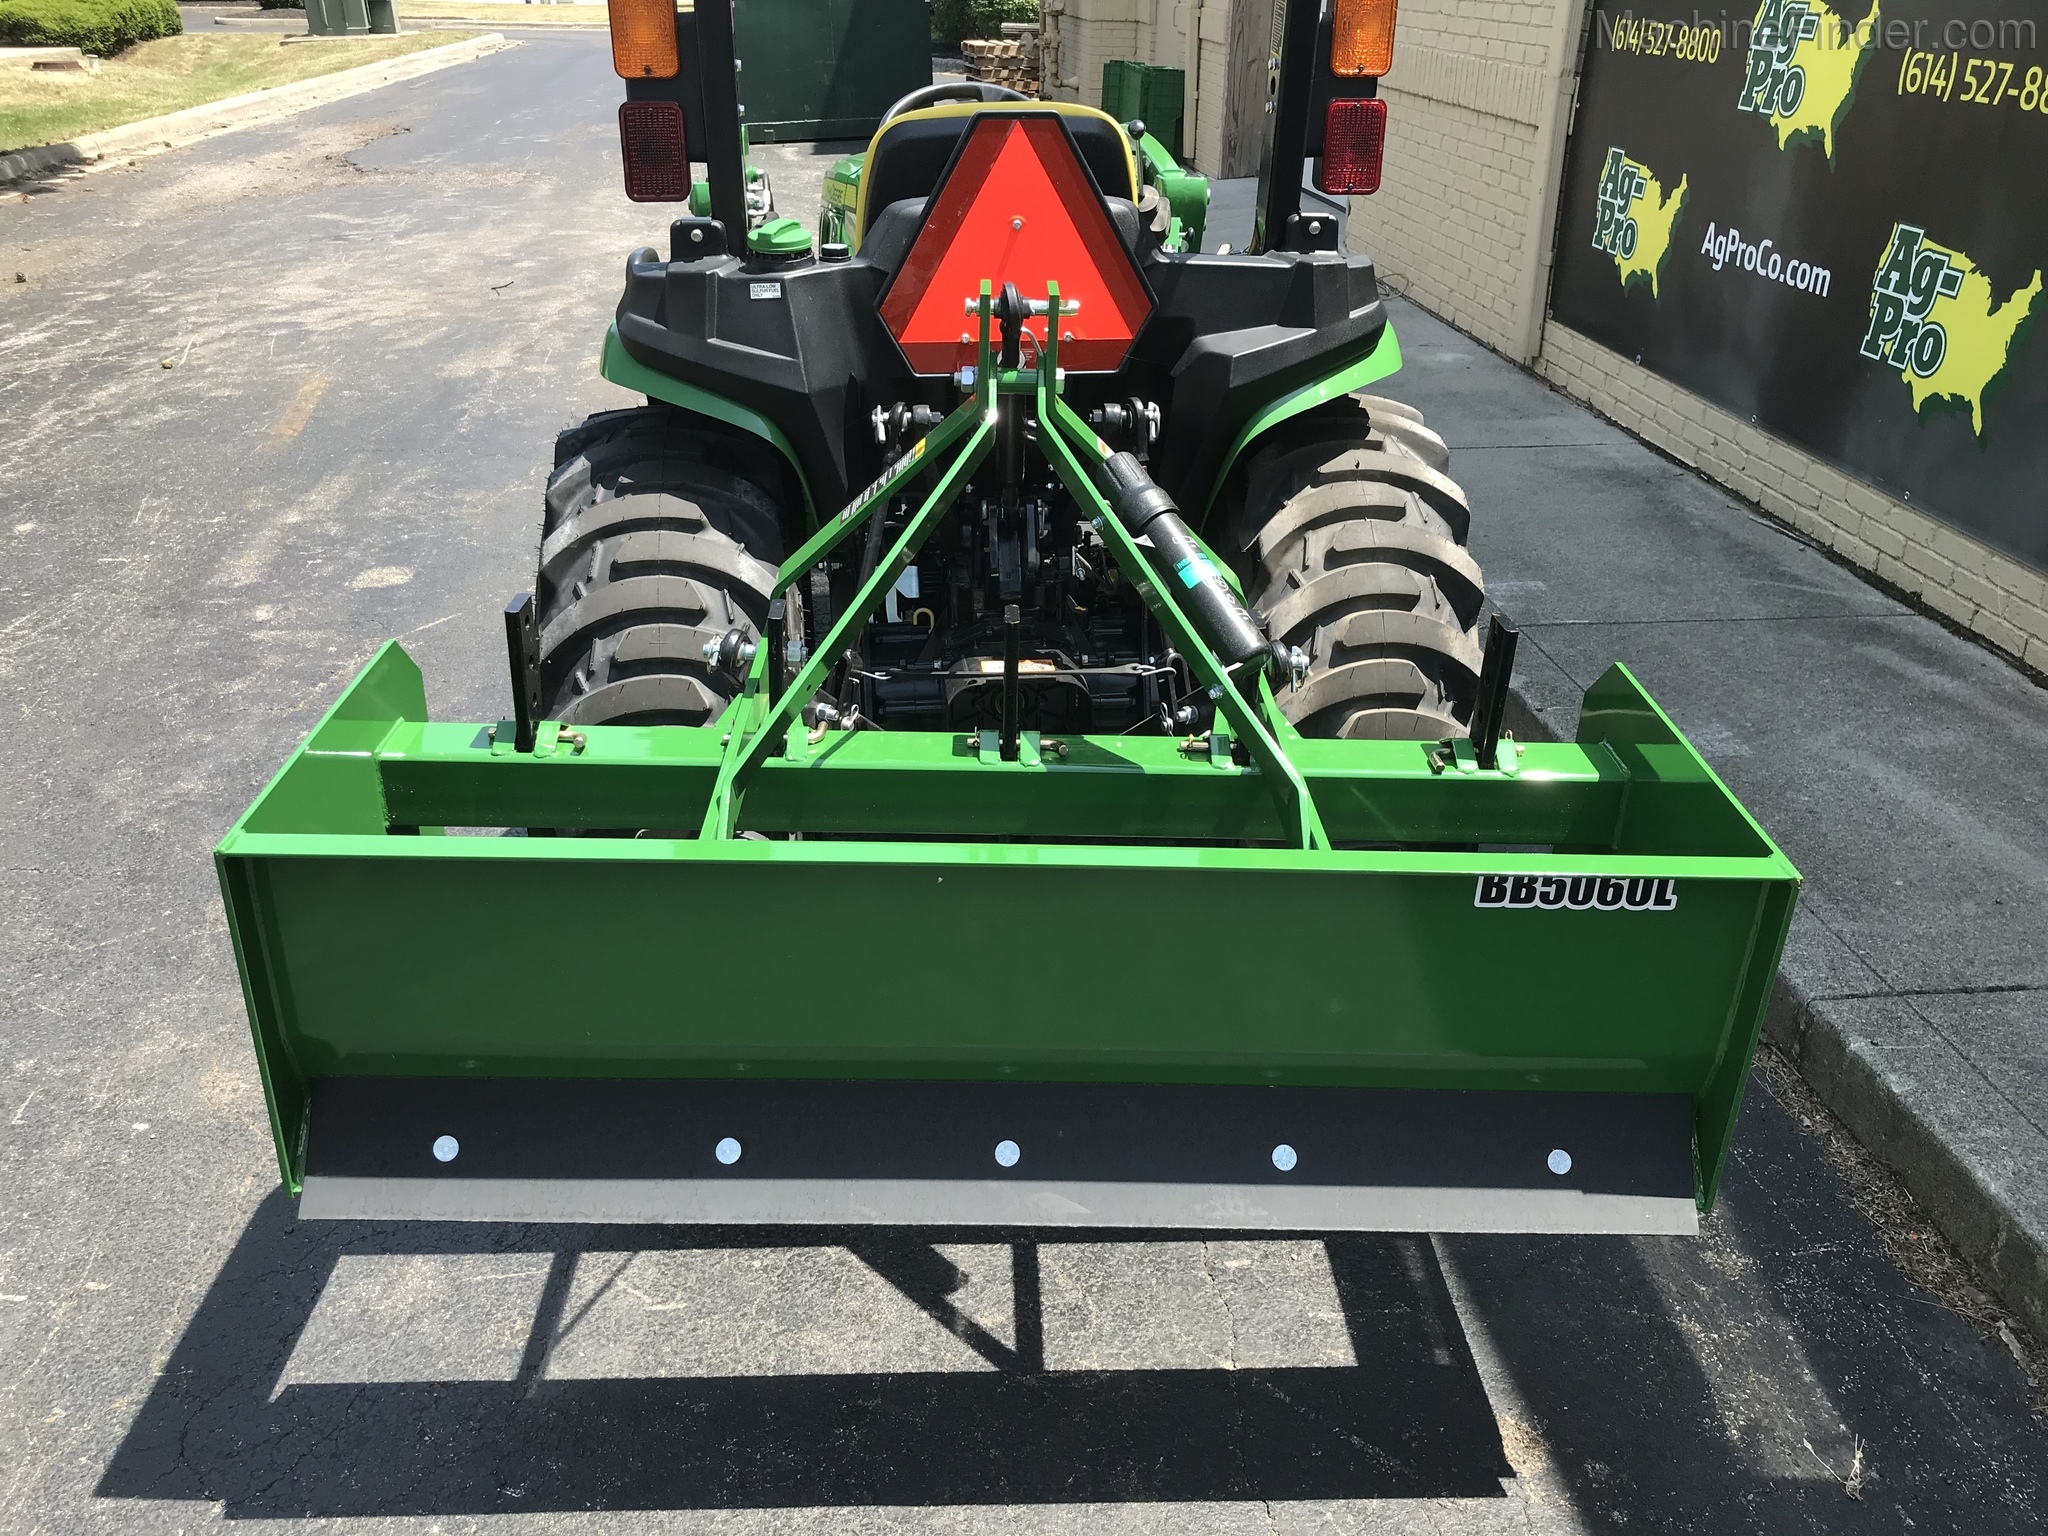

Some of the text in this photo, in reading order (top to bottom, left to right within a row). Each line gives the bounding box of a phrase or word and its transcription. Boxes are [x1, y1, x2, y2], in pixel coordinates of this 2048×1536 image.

[1612, 15, 1721, 64] (614) 527-8800
[1737, 48, 1806, 117] Pro
[1897, 47, 1958, 102] (614)
[1599, 147, 1647, 215] Ag-
[1592, 200, 1638, 260] Pro
[1700, 222, 1831, 298] AgProCo.com
[1873, 223, 1964, 317] Ag-
[1859, 290, 1946, 377] Pro
